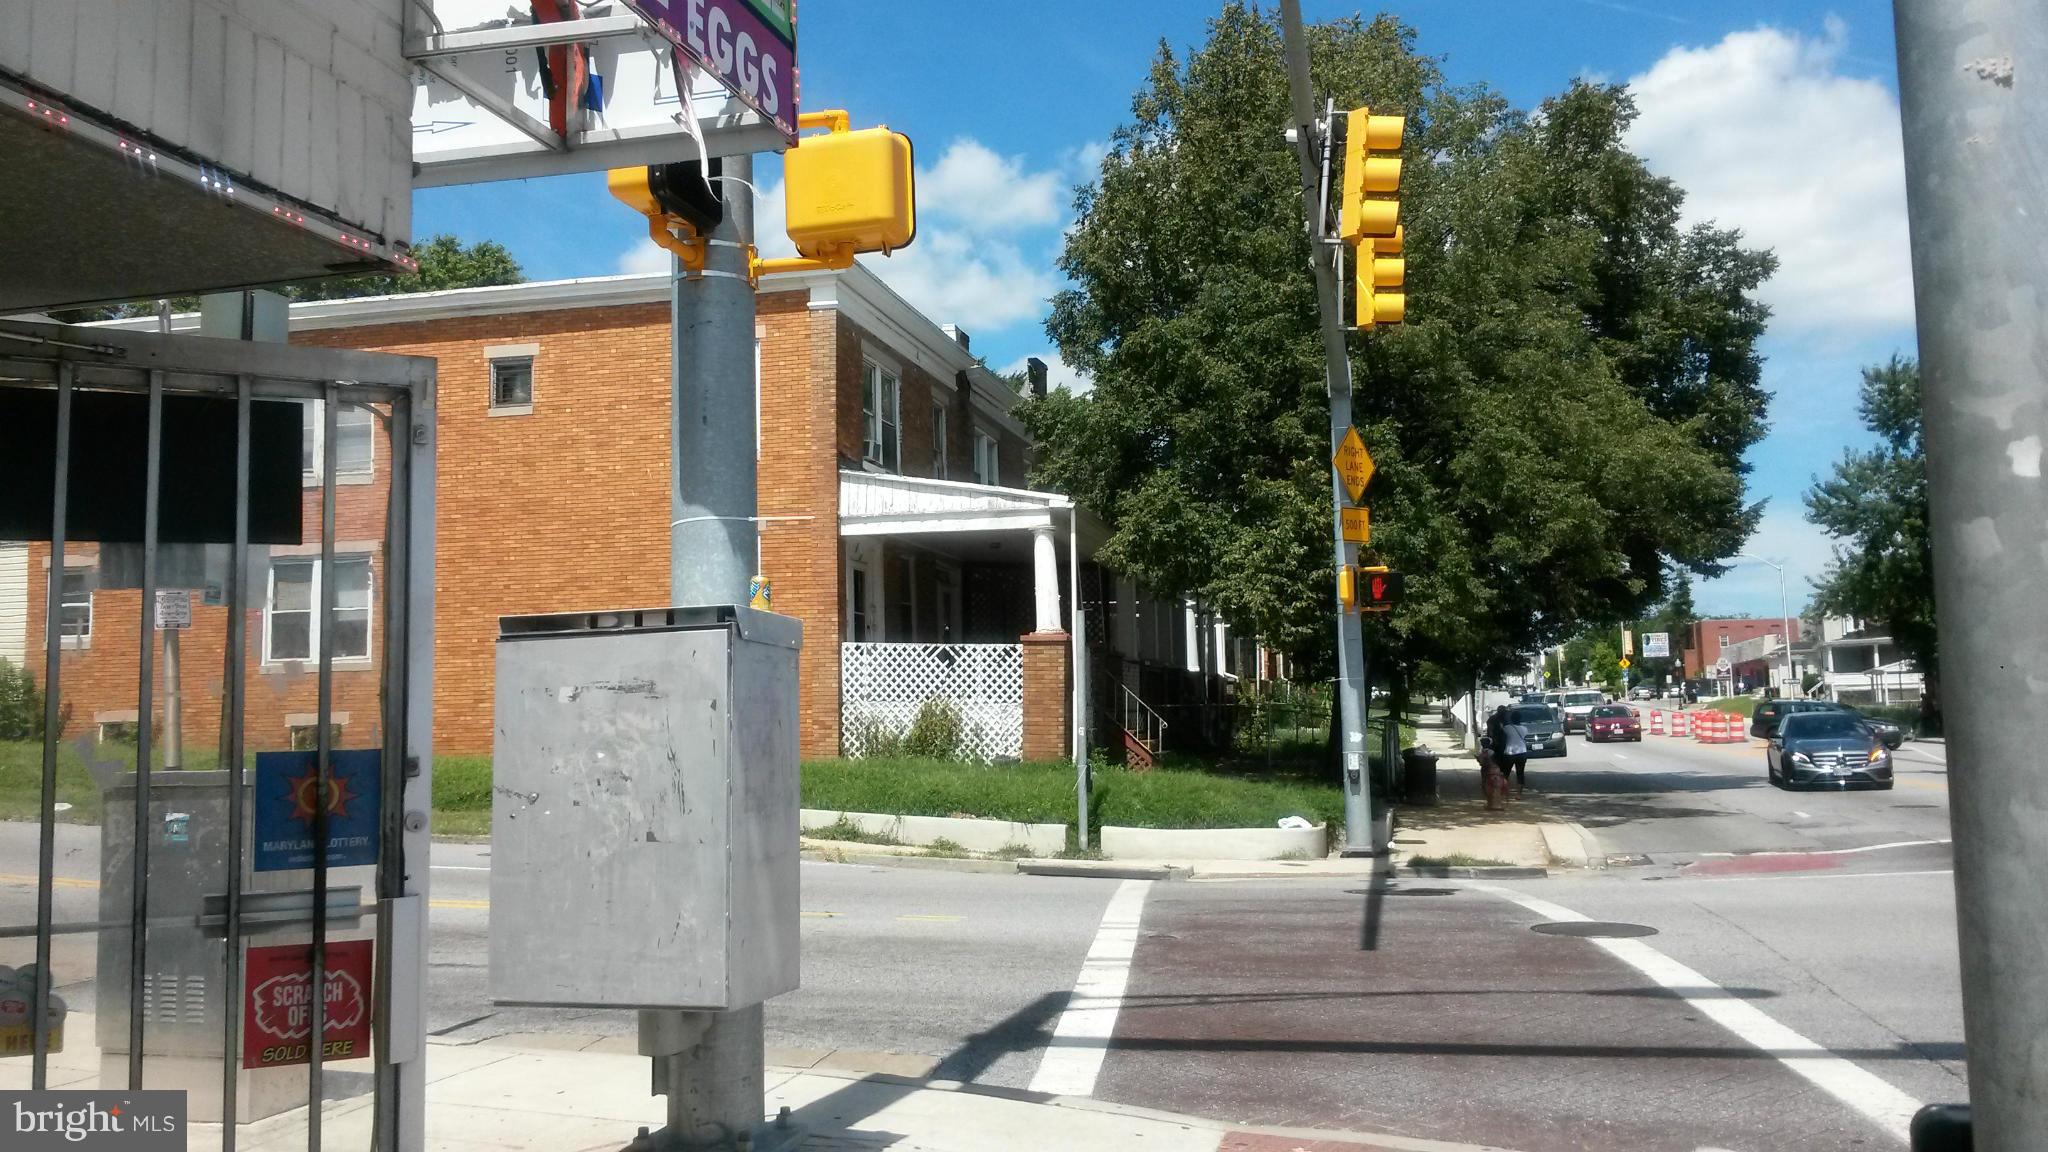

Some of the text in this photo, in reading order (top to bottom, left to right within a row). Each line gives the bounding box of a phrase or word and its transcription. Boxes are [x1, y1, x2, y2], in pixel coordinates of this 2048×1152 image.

[687, 0, 779, 115] EGGS
[1343, 445, 1364, 458] RIGHT
[1345, 462, 1363, 473] LANE
[1346, 475, 1365, 488] ENDS
[1345, 519, 1358, 530] 500
[262, 839, 315, 852] MARYLAN
[273, 981, 343, 1007] SCRACH
[262, 1041, 353, 1062] SOLD ERE
